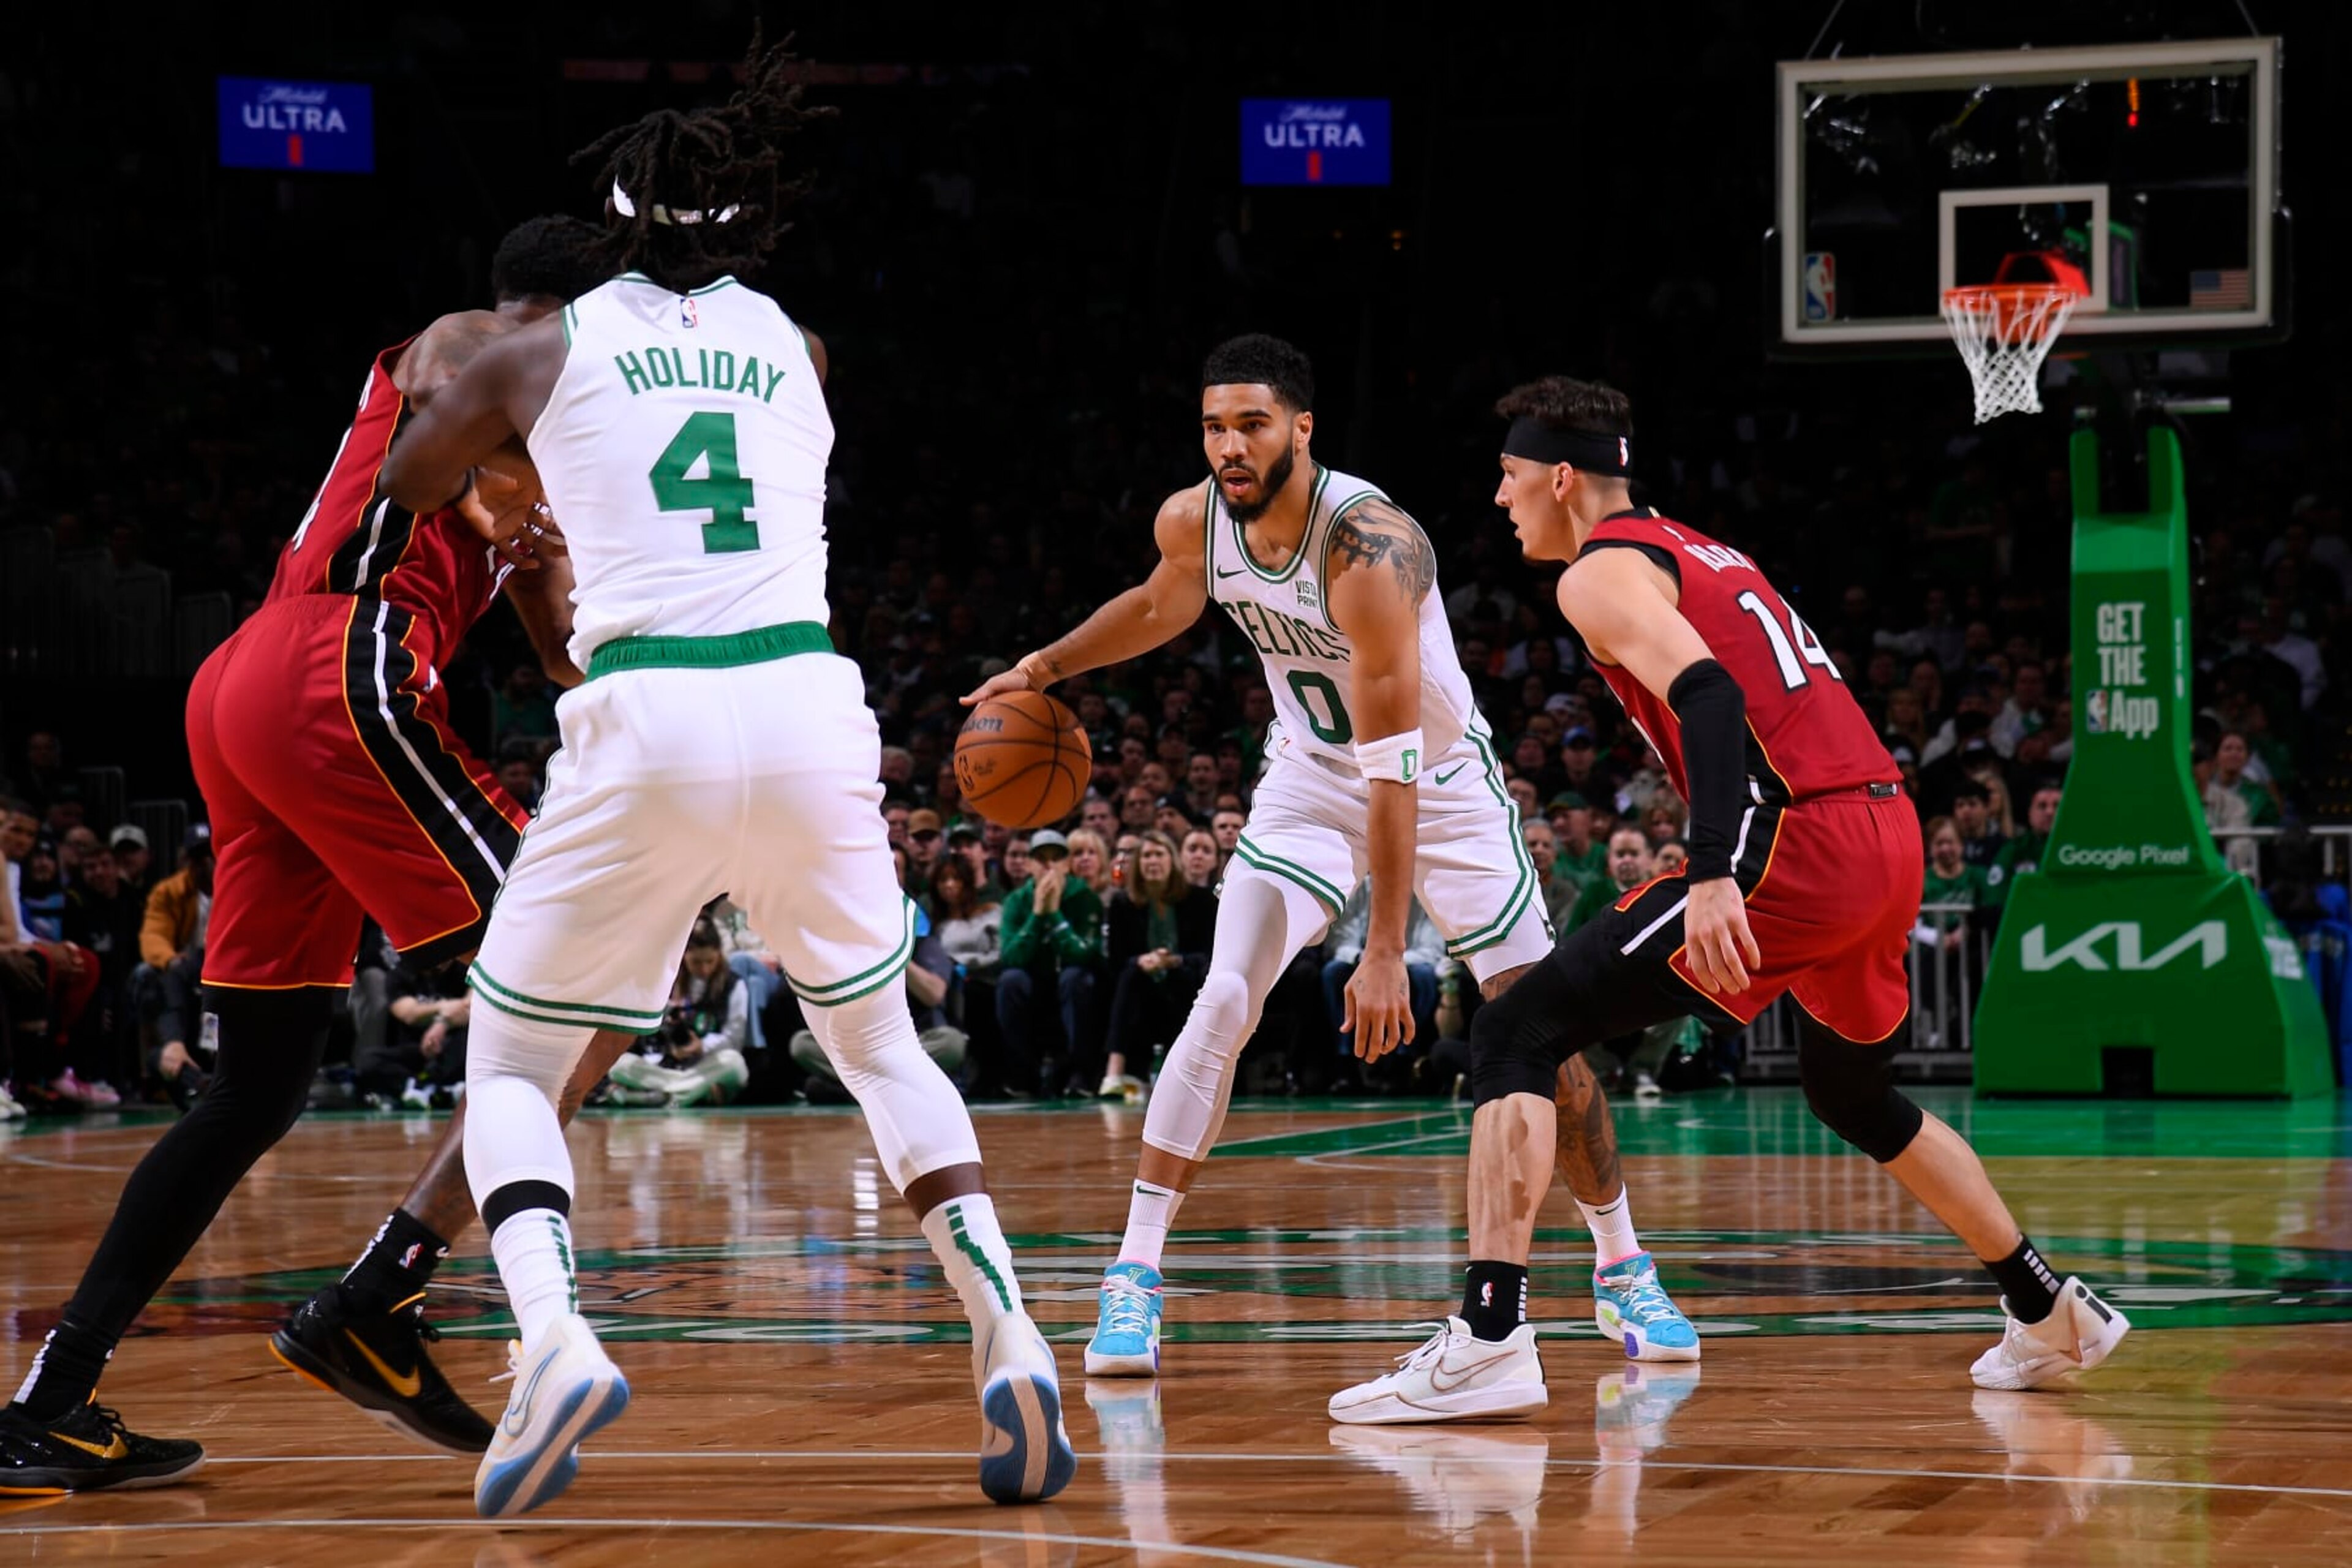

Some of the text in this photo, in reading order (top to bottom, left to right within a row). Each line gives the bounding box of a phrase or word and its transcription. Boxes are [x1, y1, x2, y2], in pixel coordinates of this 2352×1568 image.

[241, 102, 348, 133] ULTRA
[1264, 123, 1365, 148] ULTRA
[614, 347, 786, 404] HOLIDAY
[649, 411, 761, 554] 4
[1736, 589, 1842, 693] 14
[2097, 601, 2145, 643] GET
[2097, 645, 2147, 687] THE
[1286, 669, 1353, 744] 0
[2109, 690, 2159, 740] App
[2059, 845, 2190, 870] Google Pixel
[2021, 920, 2227, 972] KIA
